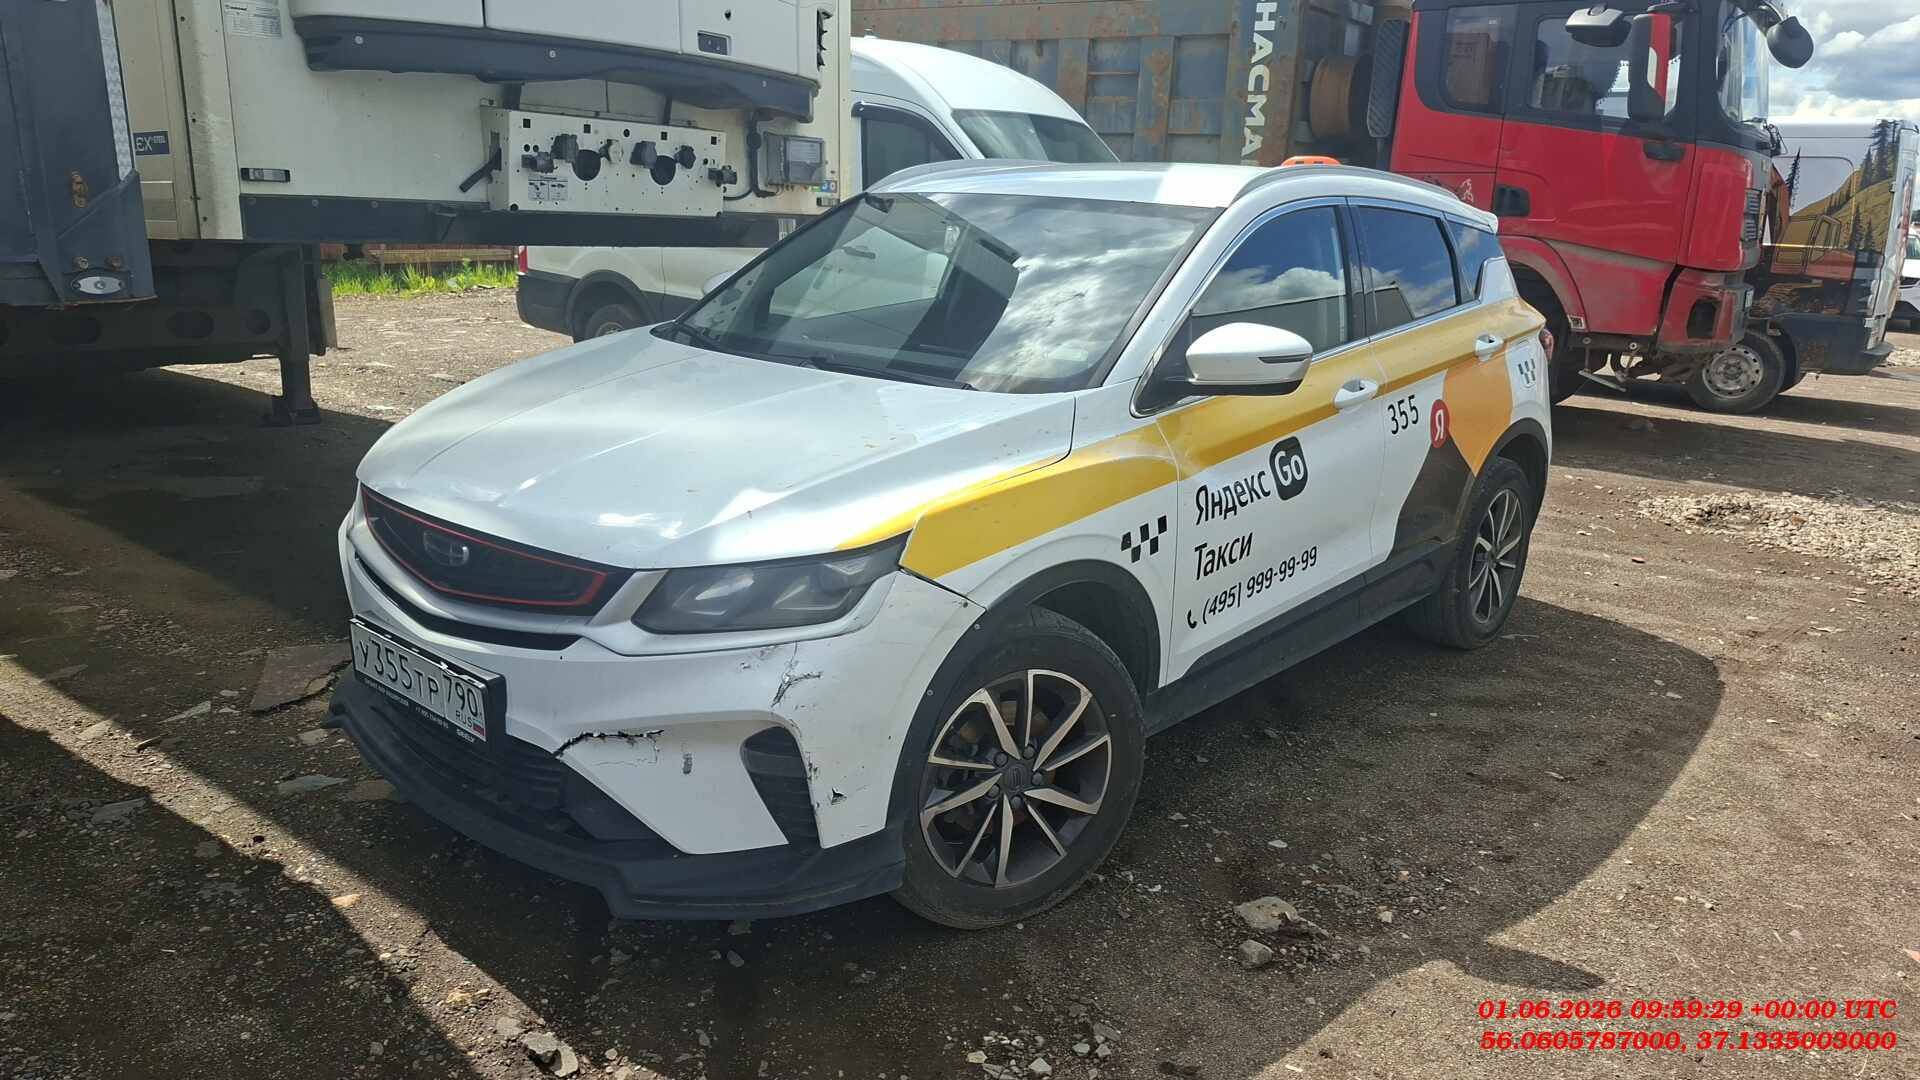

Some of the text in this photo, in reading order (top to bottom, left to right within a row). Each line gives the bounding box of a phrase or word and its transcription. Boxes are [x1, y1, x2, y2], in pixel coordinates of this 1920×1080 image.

[1240, 0, 1277, 166] HACMA
[1387, 394, 1419, 435] 355
[1434, 408, 1445, 441] Я
[1195, 450, 1305, 526] Яндекс Go
[1194, 532, 1254, 581] Такси
[1246, 546, 1318, 598] 999-99-99
[455, 710, 473, 728] RUS
